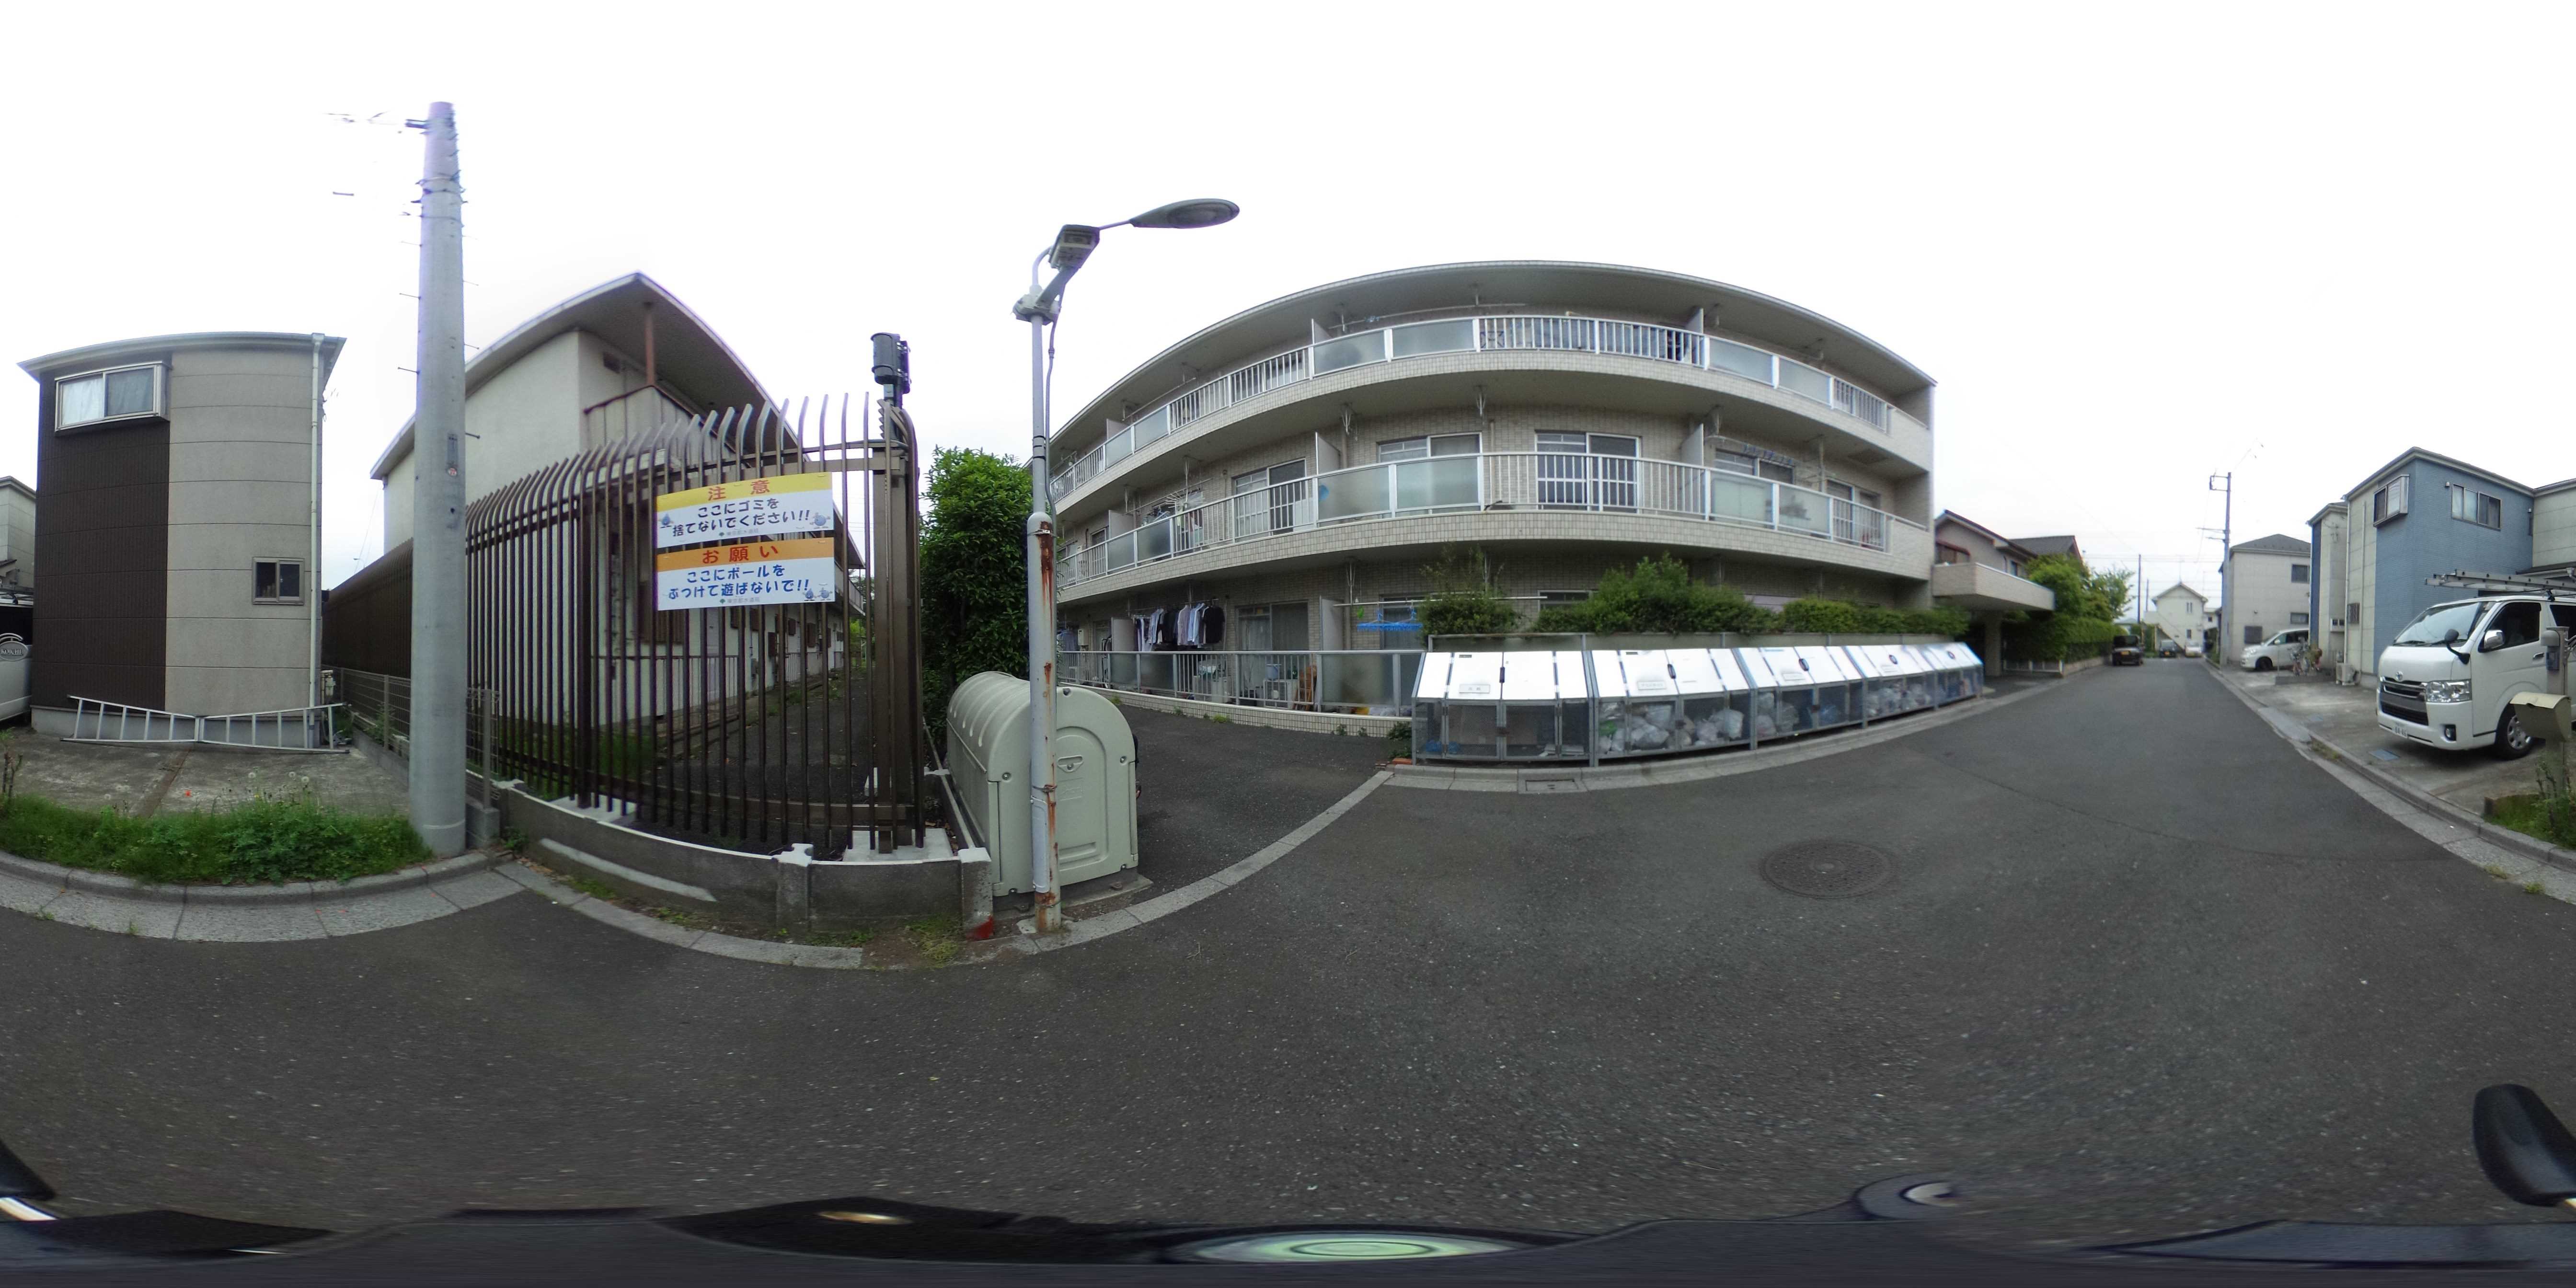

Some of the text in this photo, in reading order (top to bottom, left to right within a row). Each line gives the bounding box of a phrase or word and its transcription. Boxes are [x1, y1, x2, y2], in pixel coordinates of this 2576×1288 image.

[708, 480, 770, 501] 注意
[698, 498, 779, 518] ここにゴミを
[672, 510, 810, 537] 捨てないでください!!
[702, 546, 778, 564] お願い
[687, 564, 785, 583] ここにボールを
[668, 579, 809, 600] ぶつけて遊ばないで!!
